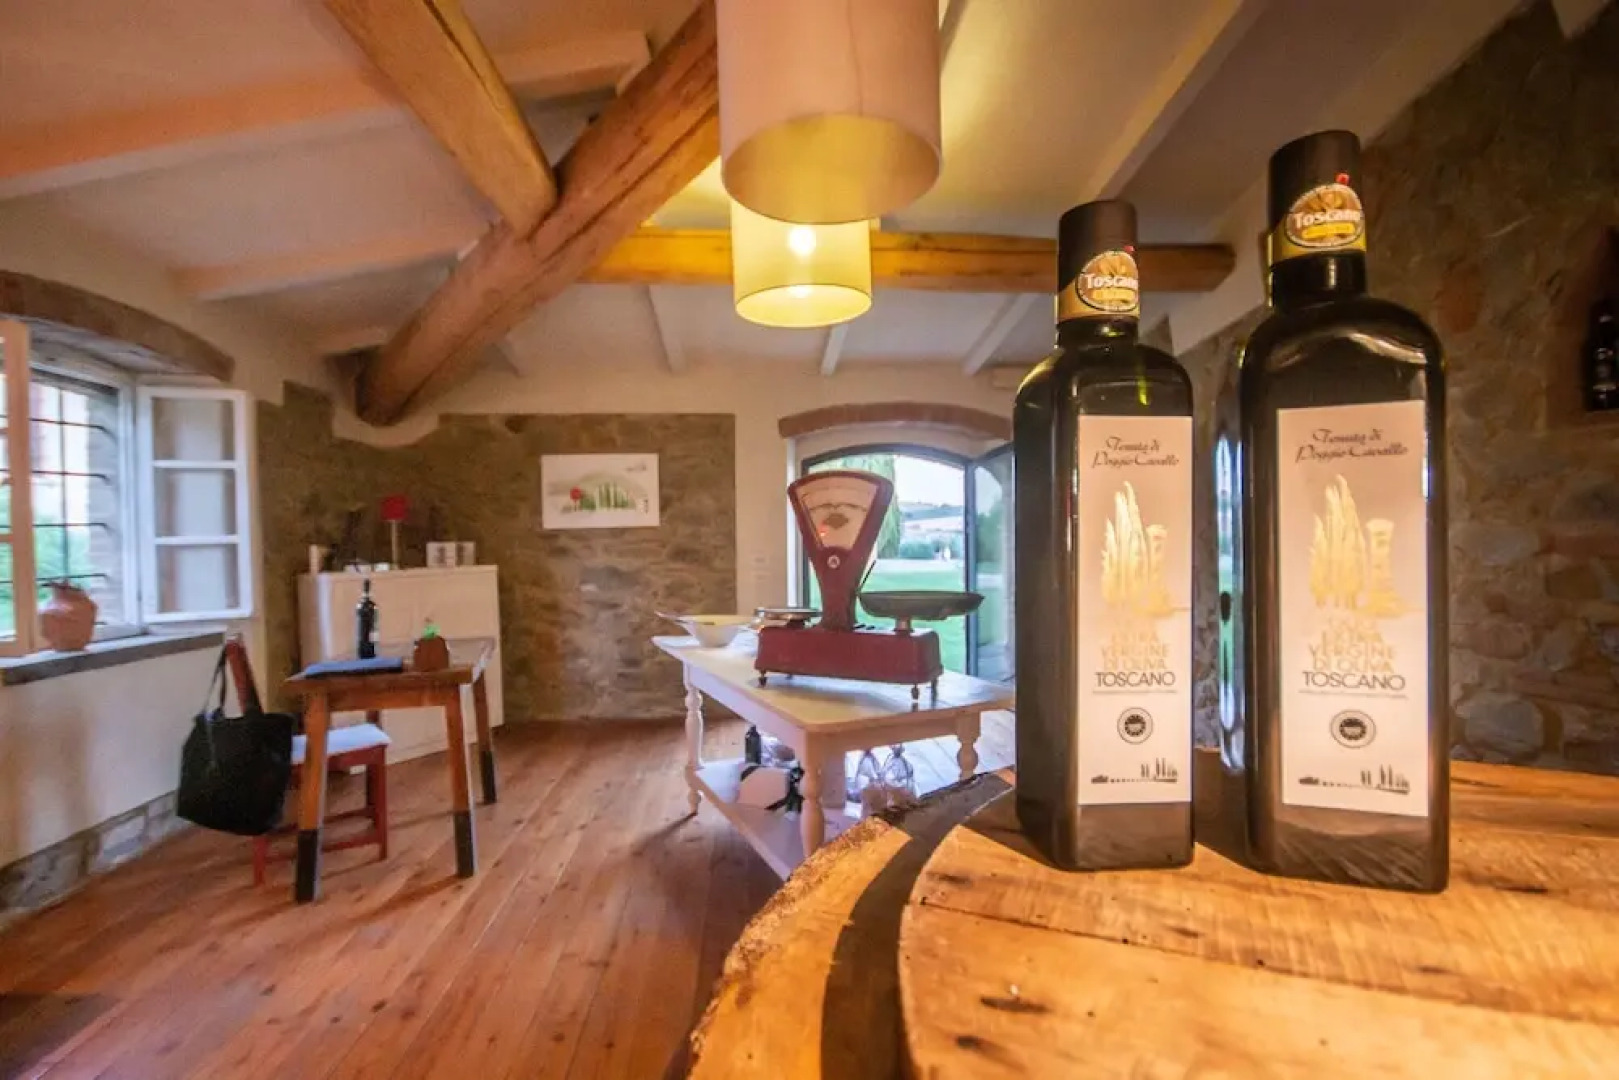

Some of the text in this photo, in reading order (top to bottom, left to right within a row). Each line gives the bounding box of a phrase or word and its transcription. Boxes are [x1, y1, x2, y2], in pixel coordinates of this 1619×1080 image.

[1150, 438, 1160, 452] di
[1095, 671, 1176, 688] TOSCANO
[1302, 671, 1405, 690] TOSCANO
